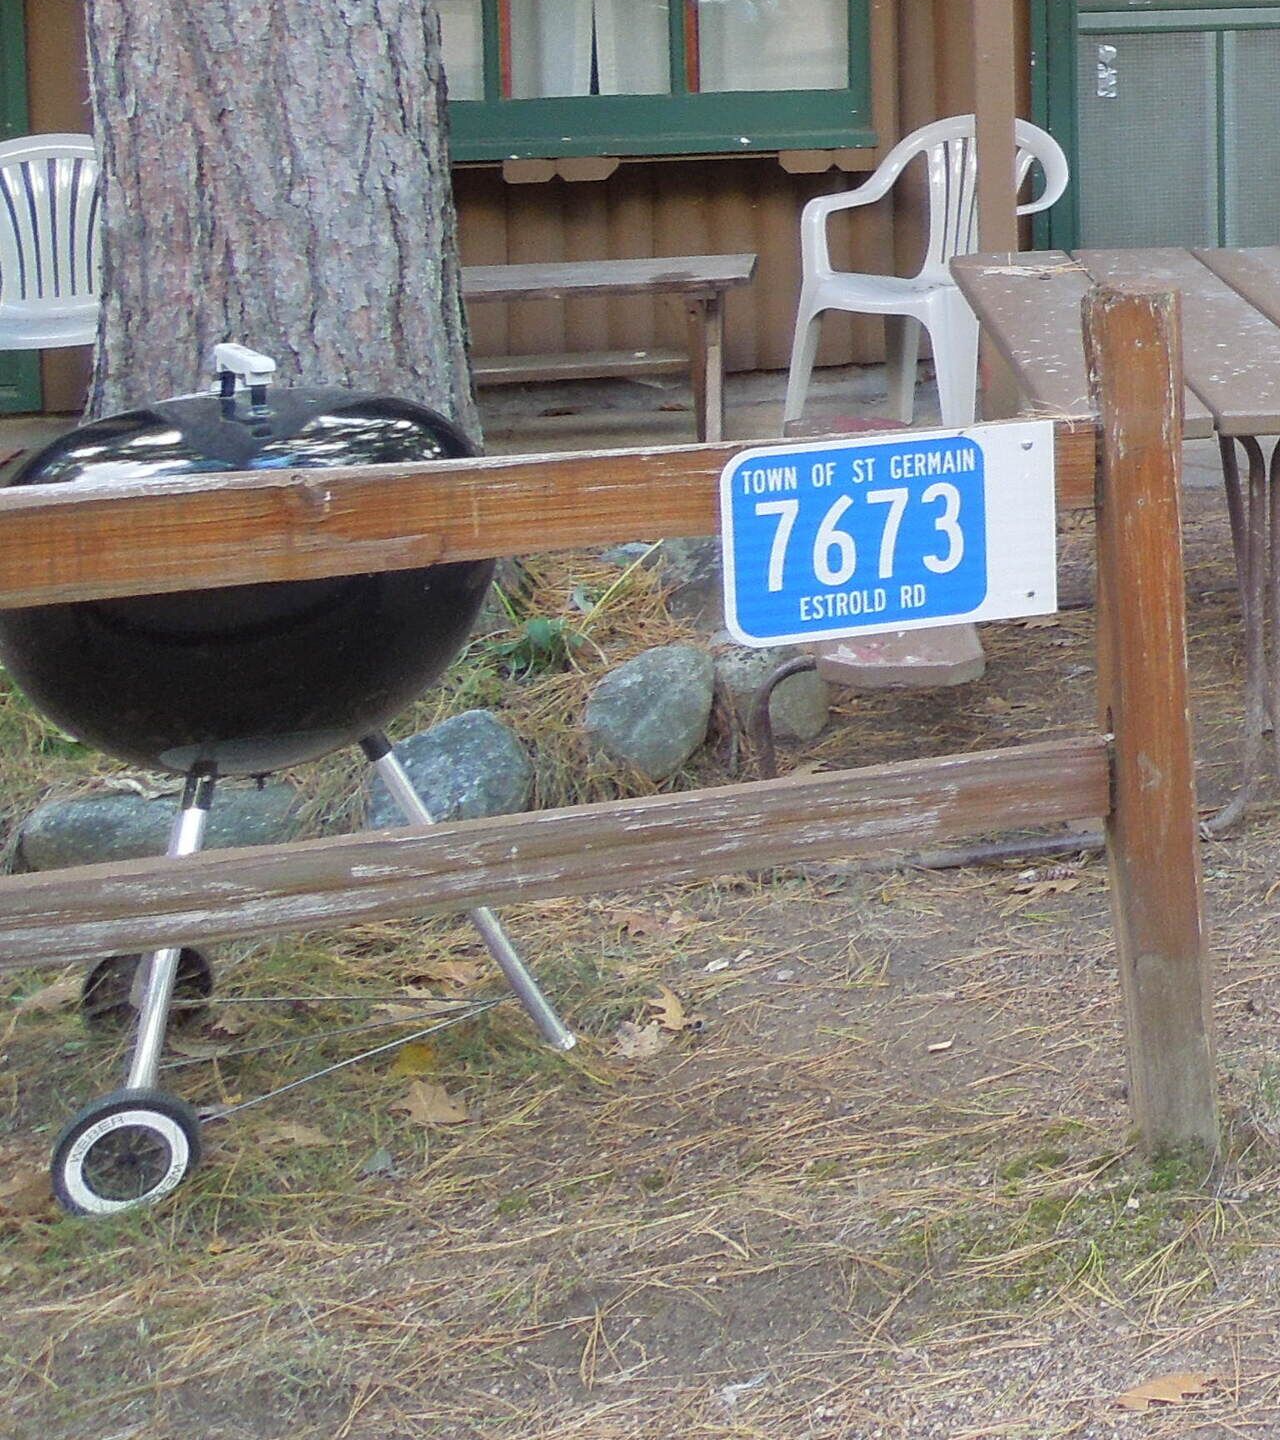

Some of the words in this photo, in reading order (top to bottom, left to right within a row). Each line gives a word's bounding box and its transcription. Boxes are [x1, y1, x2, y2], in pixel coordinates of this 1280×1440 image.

[741, 468, 797, 495] TOWN
[812, 463, 836, 487] OF
[852, 459, 875, 483] ST
[890, 448, 976, 478] GERMAIN
[755, 482, 965, 592] 7673
[800, 590, 887, 622] ESTROLD
[900, 584, 926, 609] RD
[70, 1115, 125, 1163] WEBER
